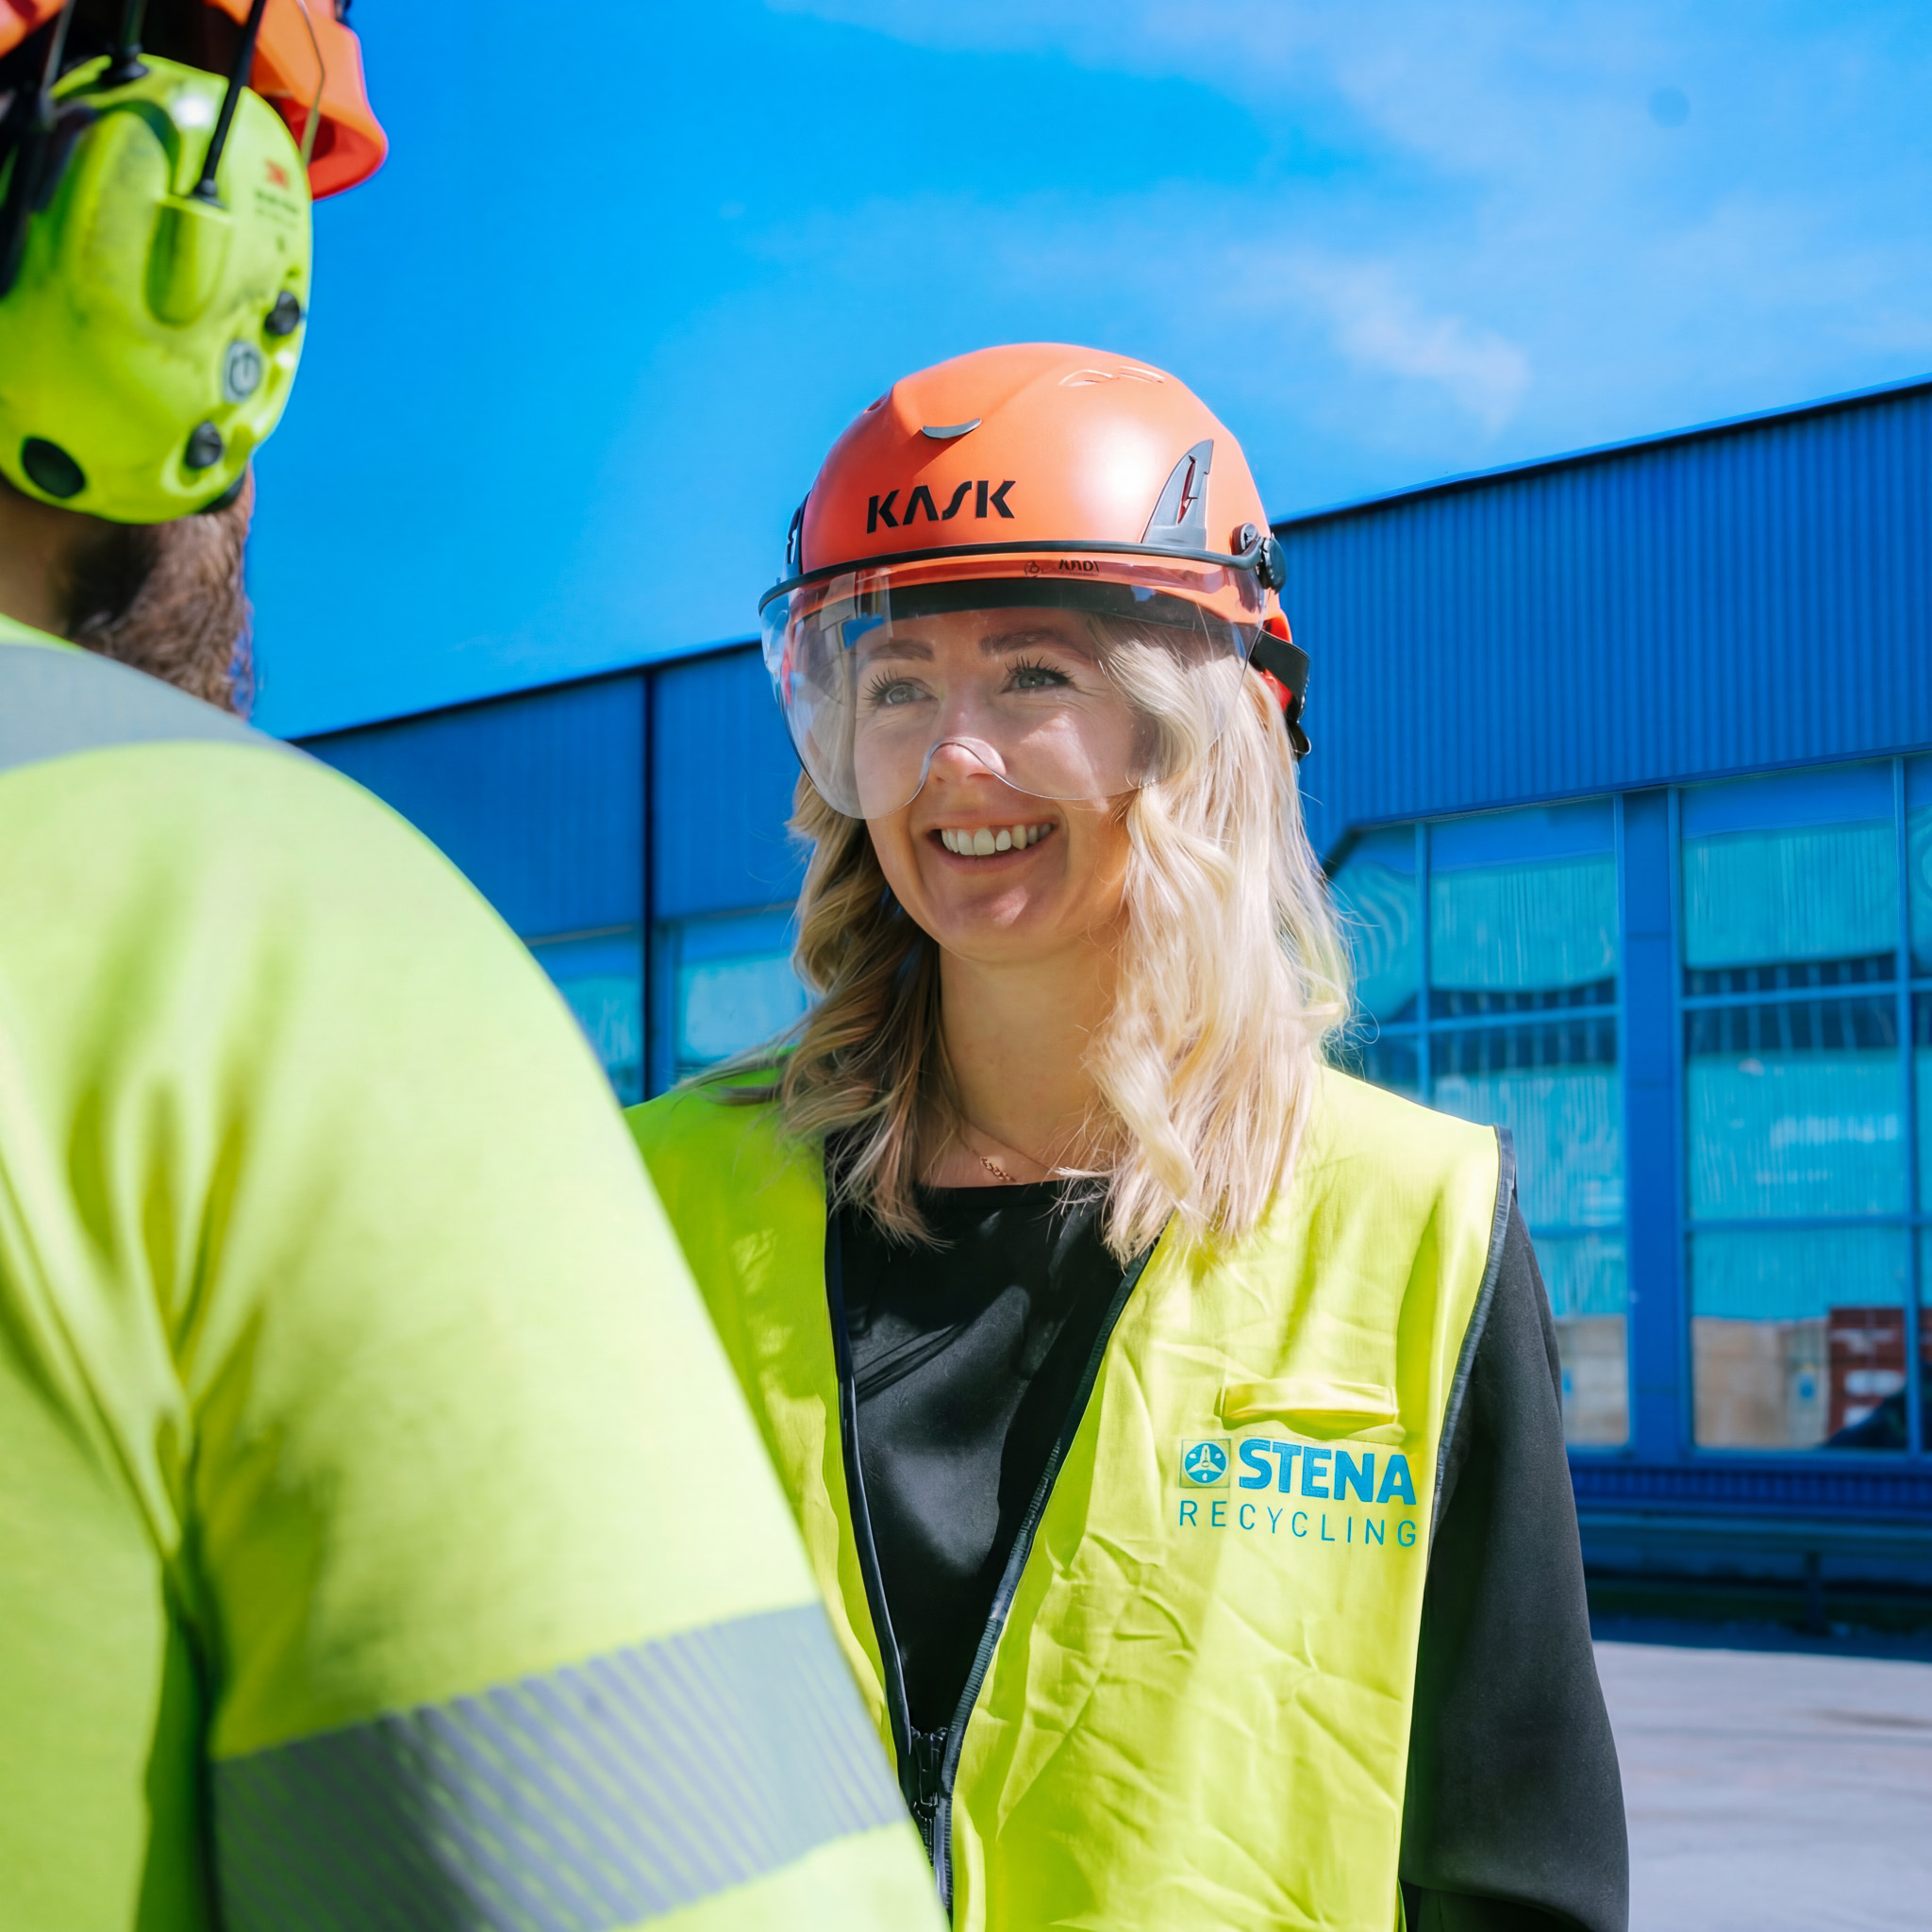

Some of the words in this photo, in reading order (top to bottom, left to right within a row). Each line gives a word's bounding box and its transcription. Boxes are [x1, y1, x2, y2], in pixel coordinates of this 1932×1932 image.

[867, 480, 1016, 534] KASK
[1239, 1439, 1417, 1506] STENA
[1179, 1500, 1417, 1547] RECYCLING
